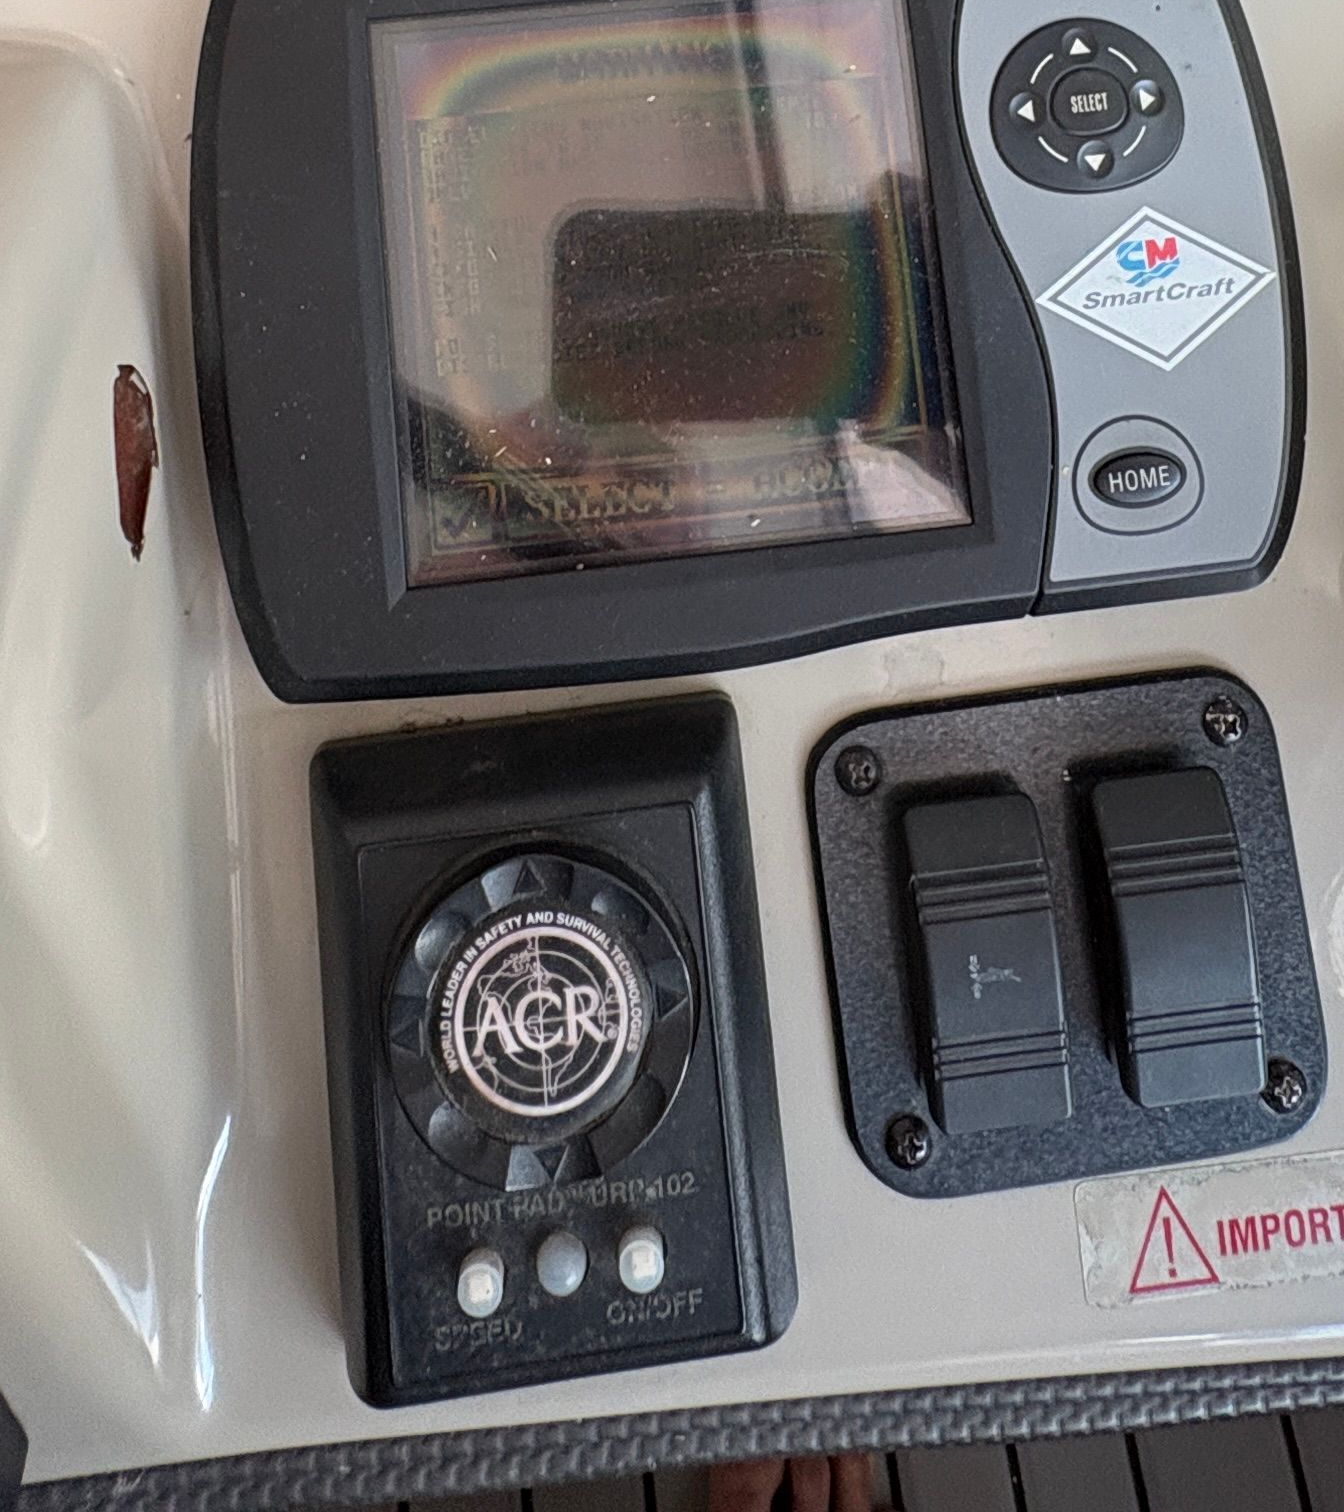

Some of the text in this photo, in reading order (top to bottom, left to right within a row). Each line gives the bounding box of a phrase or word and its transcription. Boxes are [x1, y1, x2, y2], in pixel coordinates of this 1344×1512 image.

[1069, 91, 1109, 114] SELECT
[1082, 277, 1237, 311] SmartCraft
[1108, 464, 1171, 494] HOME
[440, 911, 643, 1074] WORLD LEADER IN SAFETY AND SURVIVAL TECHNOLOGIES
[471, 984, 610, 1057] ACR
[426, 1198, 505, 1229] POINT
